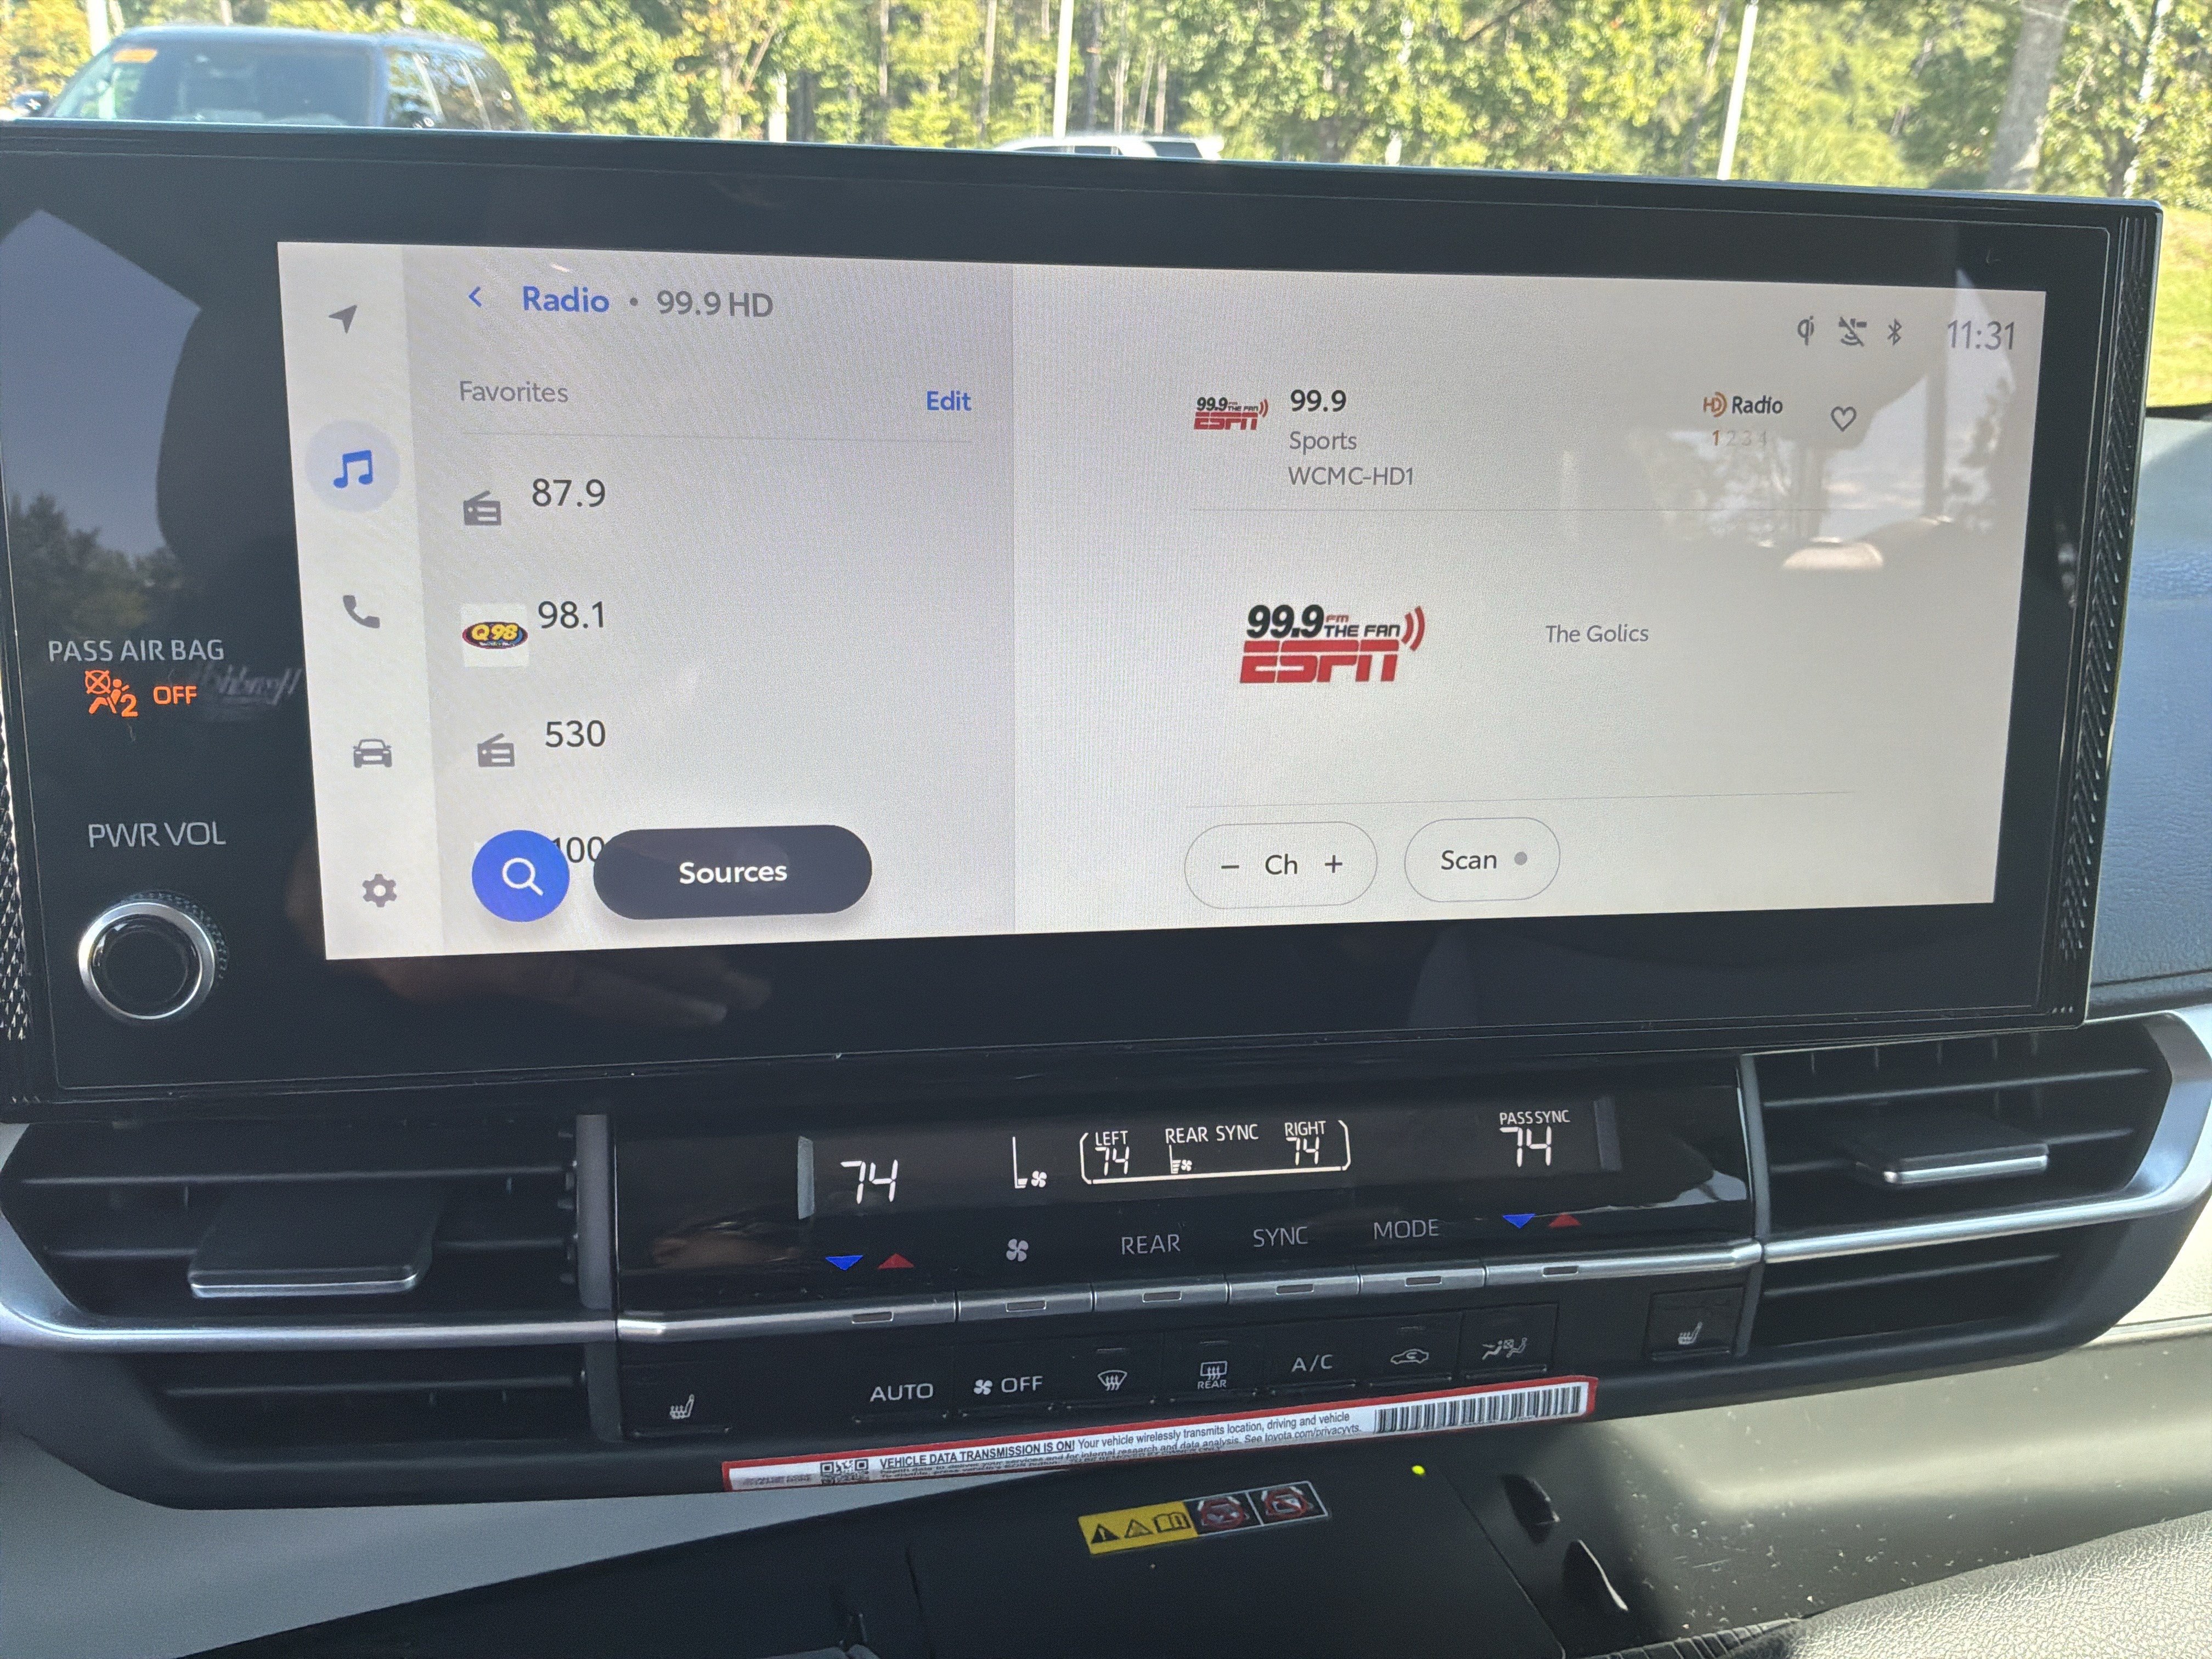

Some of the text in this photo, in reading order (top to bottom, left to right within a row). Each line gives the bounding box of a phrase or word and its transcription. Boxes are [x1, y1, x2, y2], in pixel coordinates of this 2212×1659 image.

[523, 286, 773, 317] Radio 99.9 HD
[1948, 321, 2015, 350] 11:31
[460, 381, 568, 402] Favorites
[927, 391, 971, 410] Edit
[1291, 390, 1346, 411] 99.9
[1197, 397, 1228, 411] 99.9
[1732, 395, 1783, 414] Radio
[1194, 412, 1258, 430] ESPN
[1290, 431, 1357, 455] Sports
[1288, 467, 1413, 485] WCMC-HD1
[533, 478, 605, 507] 87.9
[538, 601, 603, 628] 98.1
[1246, 605, 1324, 638] 99.9
[1324, 624, 1400, 637] THE FAN
[1546, 624, 1649, 642] The Golics
[49, 640, 223, 661] PASS AIR BAG
[1240, 640, 1399, 683] ESPN
[153, 686, 197, 704] OFF
[546, 720, 605, 747] 530
[89, 822, 225, 847] PWR VOL
[1265, 854, 1297, 874] Ch
[1441, 850, 1497, 870] Scan
[680, 862, 787, 884] Sources
[1499, 1110, 1569, 1125] PASS SYNC
[1095, 1131, 1128, 1146] LEFT
[1165, 1124, 1258, 1144] REAR SYNC
[1285, 1121, 1326, 1136] RIGHT
[1286, 1137, 1319, 1165] 74
[1500, 1127, 1551, 1166] 74
[1095, 1147, 1130, 1176] 74
[841, 1160, 898, 1203] 74
[1254, 1226, 1307, 1247] SYNC
[1374, 1219, 1438, 1239] MODE
[1122, 1234, 1180, 1254] REAR
[1292, 1355, 1331, 1372] A/C
[870, 1383, 933, 1401] AUTO
[1001, 1376, 1042, 1392] OFF
[1198, 1380, 1227, 1389] REAR
[880, 1412, 1350, 1469] VEHICLE DATA TRANSMISSION IS ON! Your vehicle wirelessly transmits location, driving and vehicle
[1160, 1442, 1177, 1452] and
[1180, 1440, 1200, 1449] data
[1203, 1436, 1241, 1447] analysis.
[1244, 1435, 1262, 1443] See
